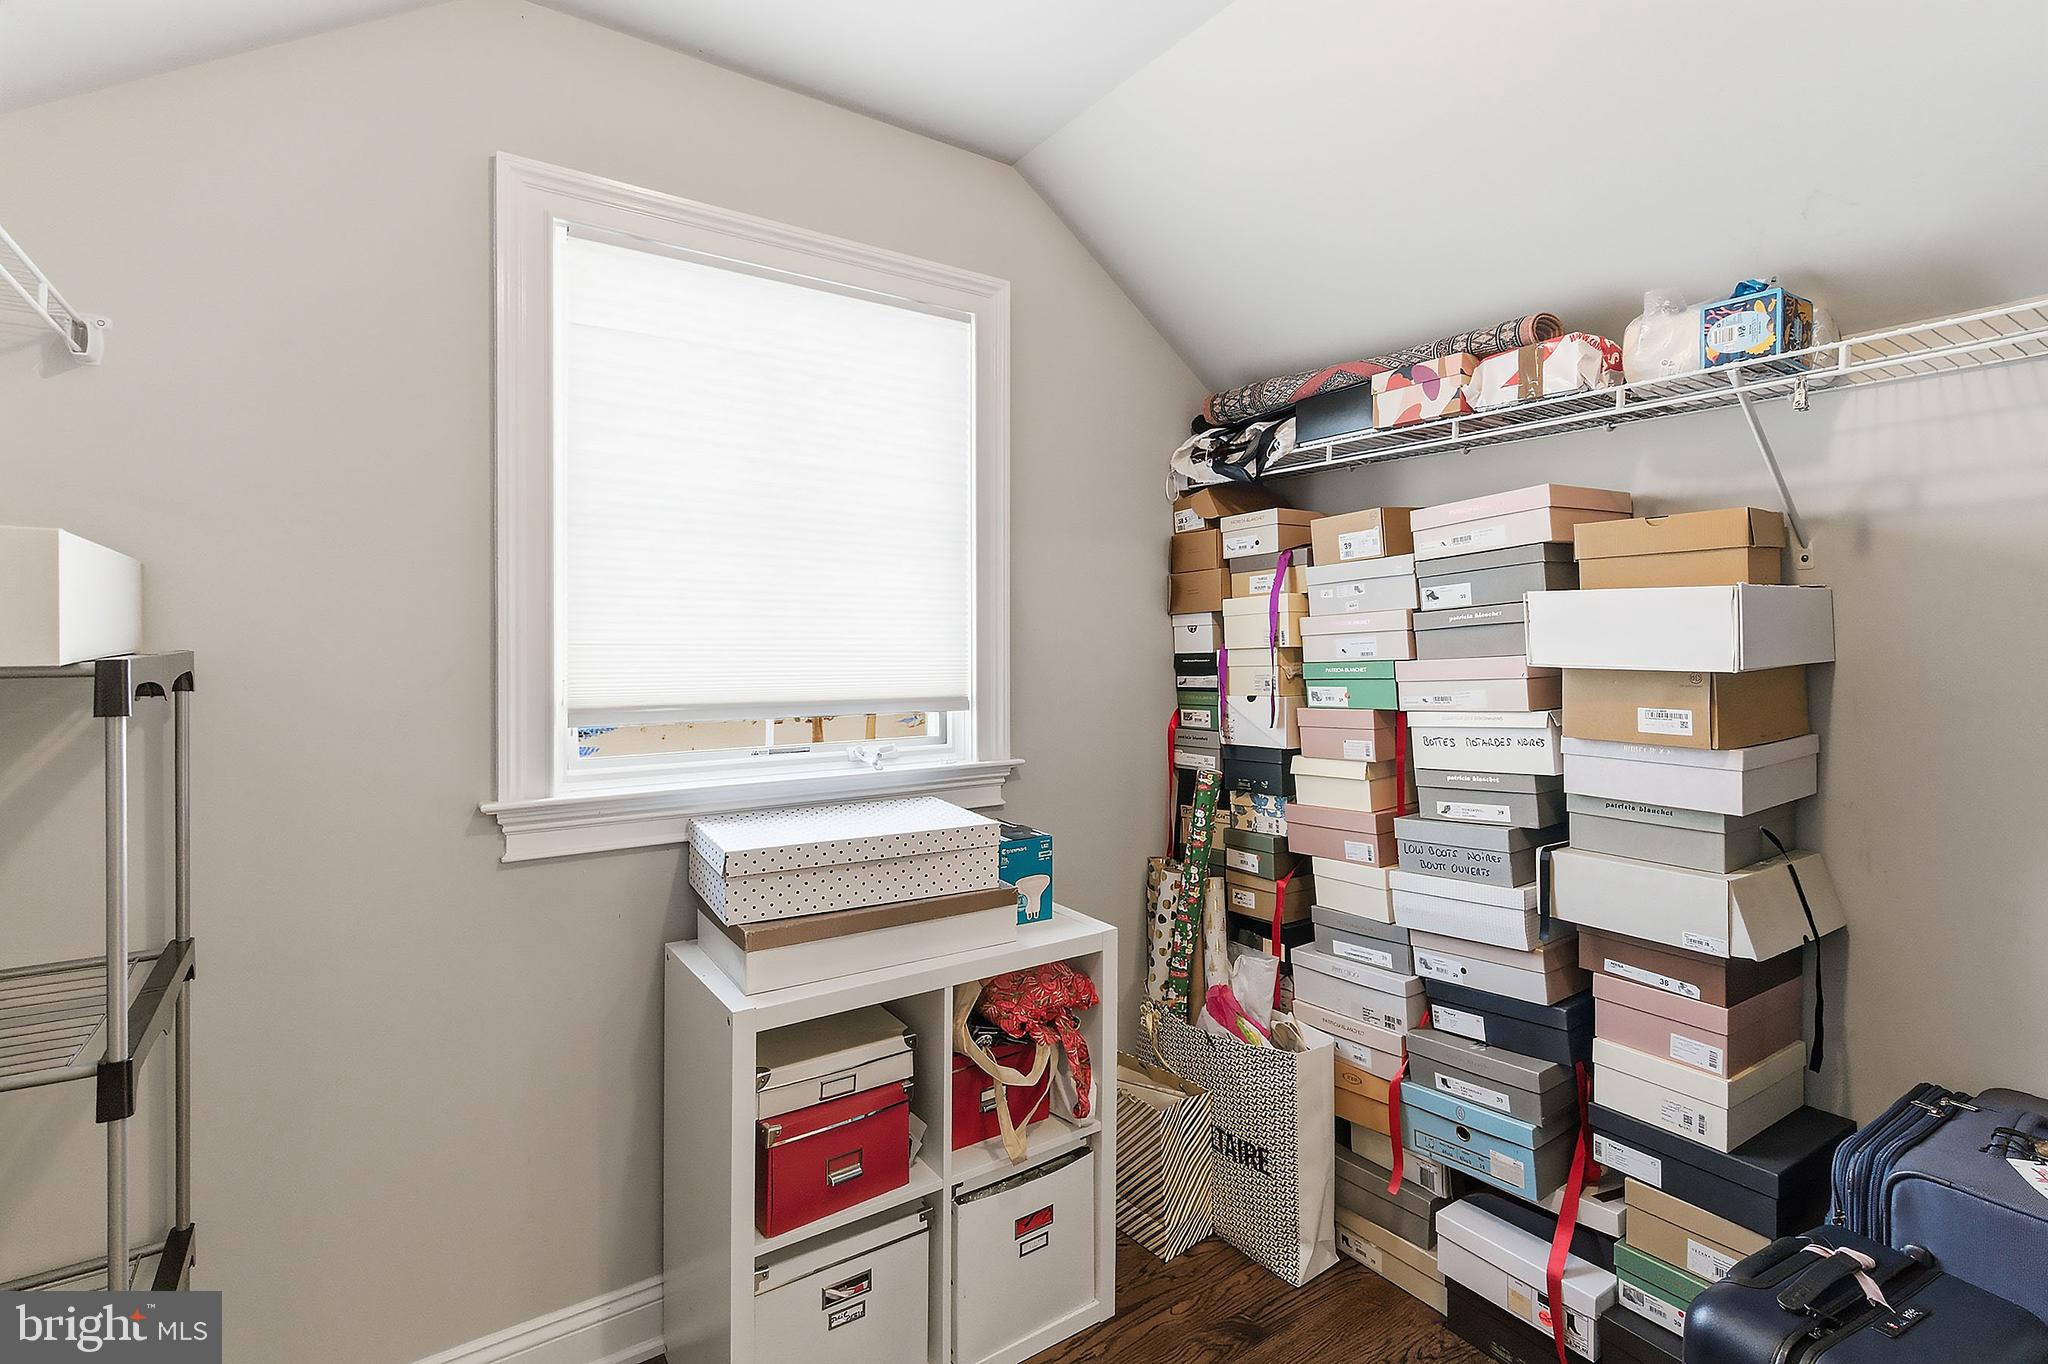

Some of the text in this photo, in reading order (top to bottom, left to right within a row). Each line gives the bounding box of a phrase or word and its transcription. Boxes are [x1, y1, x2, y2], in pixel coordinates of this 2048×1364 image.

[1449, 610, 1502, 622] patricia blanchet
[1422, 736, 1456, 747] BOTTES
[1465, 737, 1512, 748] MOTARDES
[1605, 802, 1673, 816] patricia blanchet
[1403, 843, 1502, 863] LOW BOOTS NOIRES
[1451, 863, 1490, 877] OUVERTS
